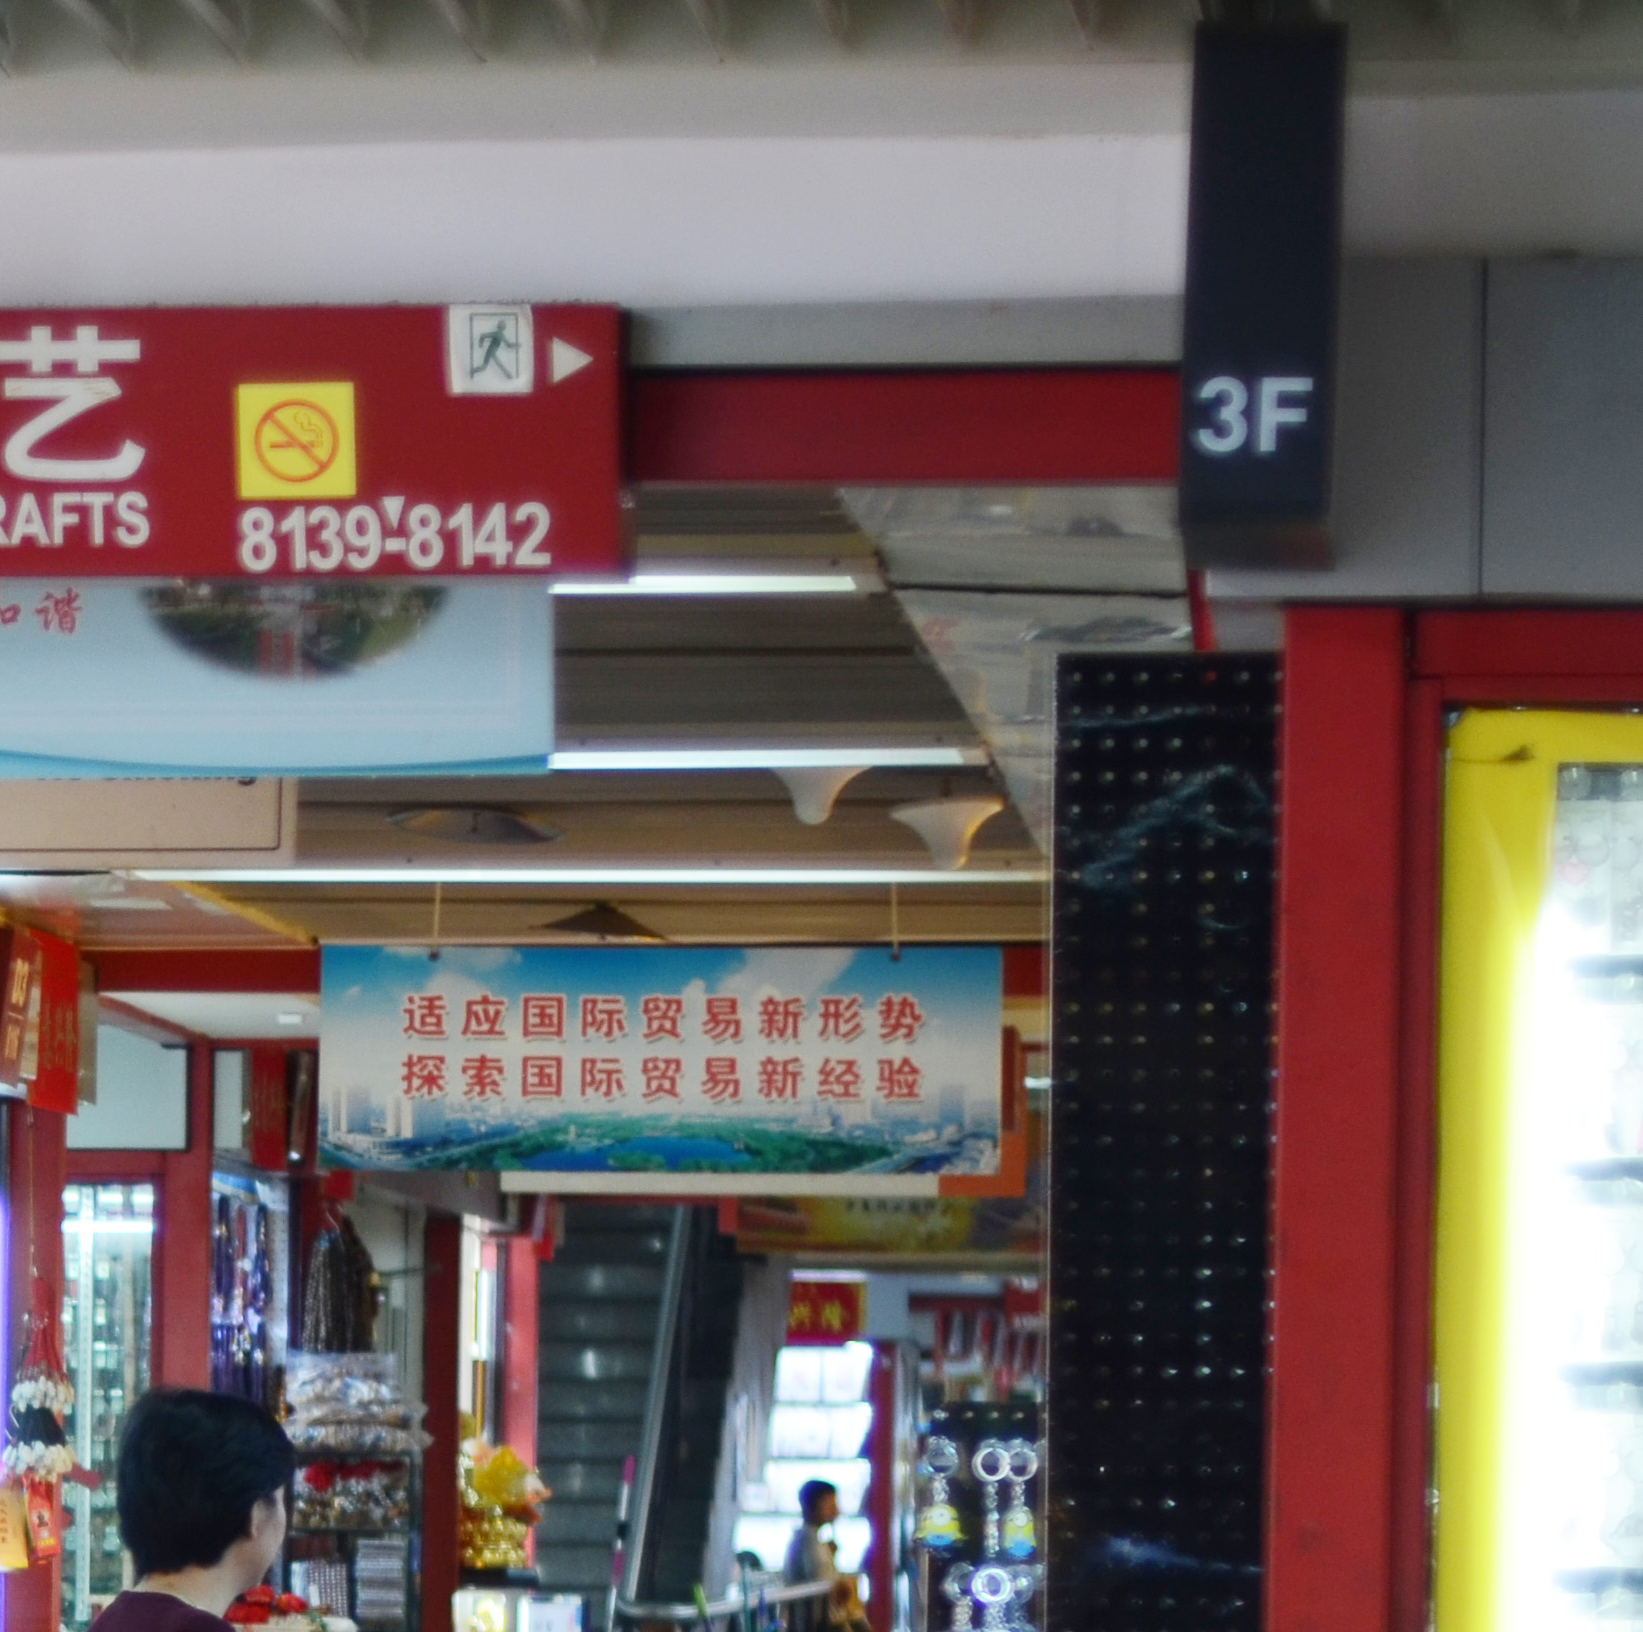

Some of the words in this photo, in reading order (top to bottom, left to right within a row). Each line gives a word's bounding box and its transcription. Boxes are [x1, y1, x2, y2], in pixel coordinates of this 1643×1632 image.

[1197, 376, 1313, 453] 3F
[239, 501, 553, 573] 8139-8142
[401, 992, 926, 1043] 适应国际贸易新形势
[399, 1052, 924, 1101] 探索国际贸易新经验
